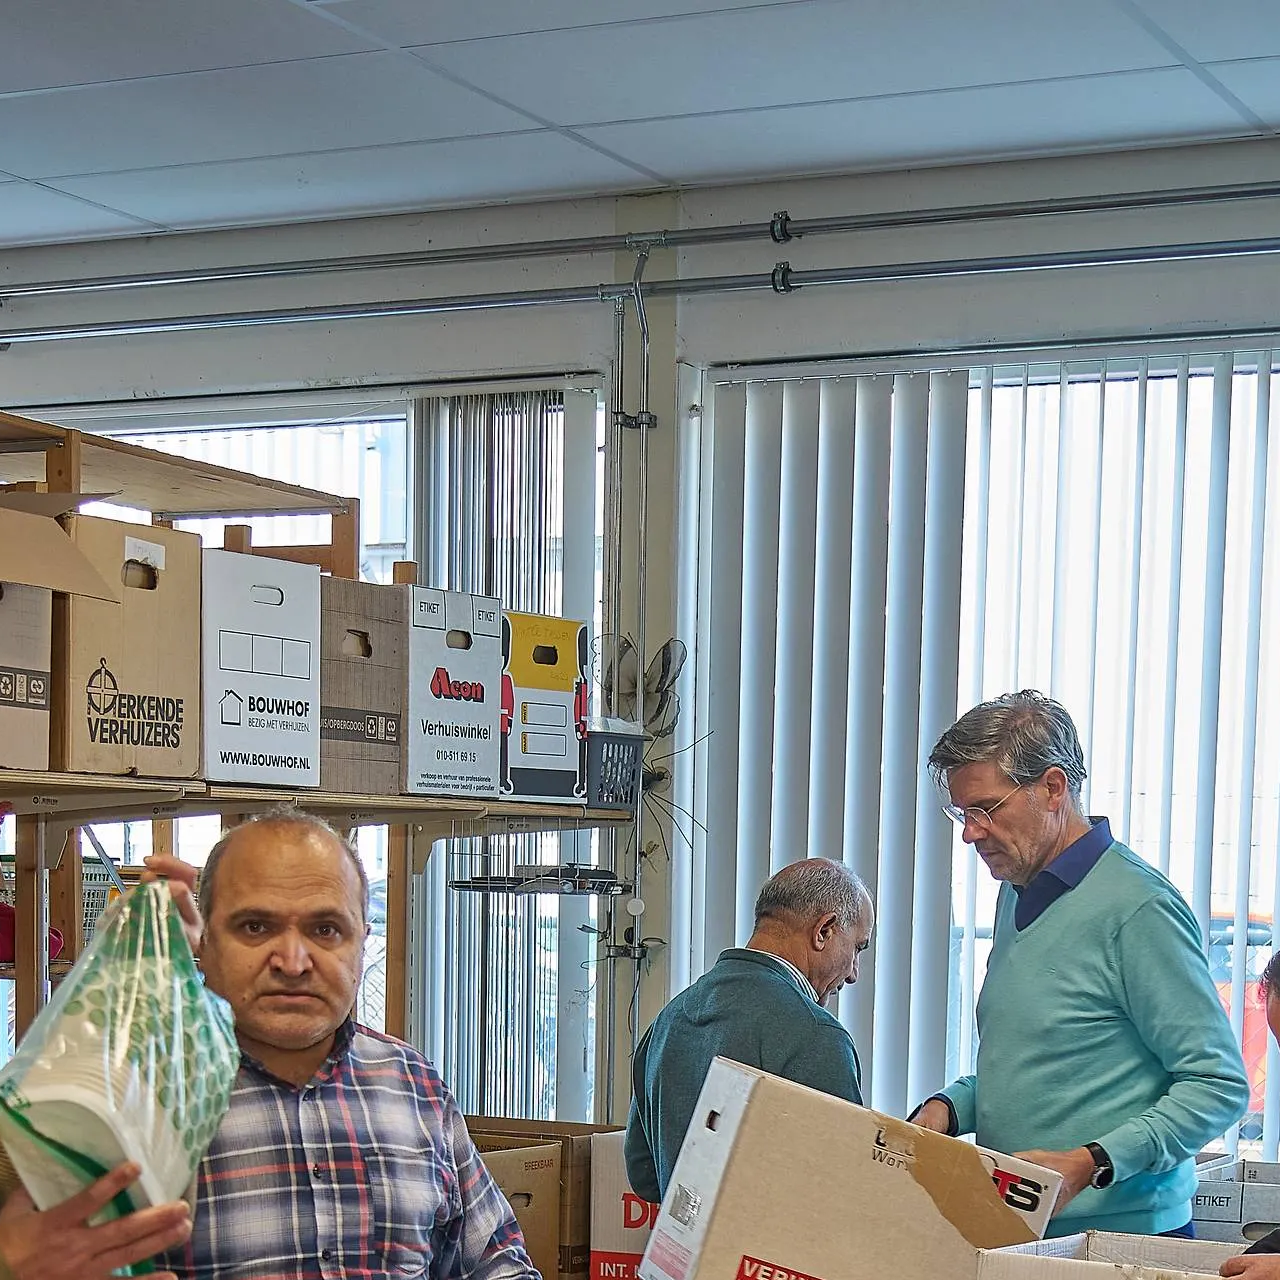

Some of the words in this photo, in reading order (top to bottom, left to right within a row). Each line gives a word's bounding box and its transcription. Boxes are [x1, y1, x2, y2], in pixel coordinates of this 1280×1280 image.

[419, 602, 440, 614] ETIKET
[478, 610, 496, 623] ETIKET
[430, 667, 485, 703] Acon
[118, 693, 183, 723] ERKENDE
[248, 695, 310, 718] BOUWHOF
[248, 716, 266, 728] BEZIG
[267, 718, 278, 730] MET
[421, 719, 491, 740] Verhuiswinkel
[87, 717, 181, 748] VERHUIZERS
[220, 751, 310, 770] WWW.BOUWHOF.NL
[436, 750, 459, 762] 010-511
[460, 751, 468, 762] 69
[469, 752, 476, 762] 15
[1195, 1195, 1232, 1207] ETIKET
[600, 1262, 628, 1278] INT.
